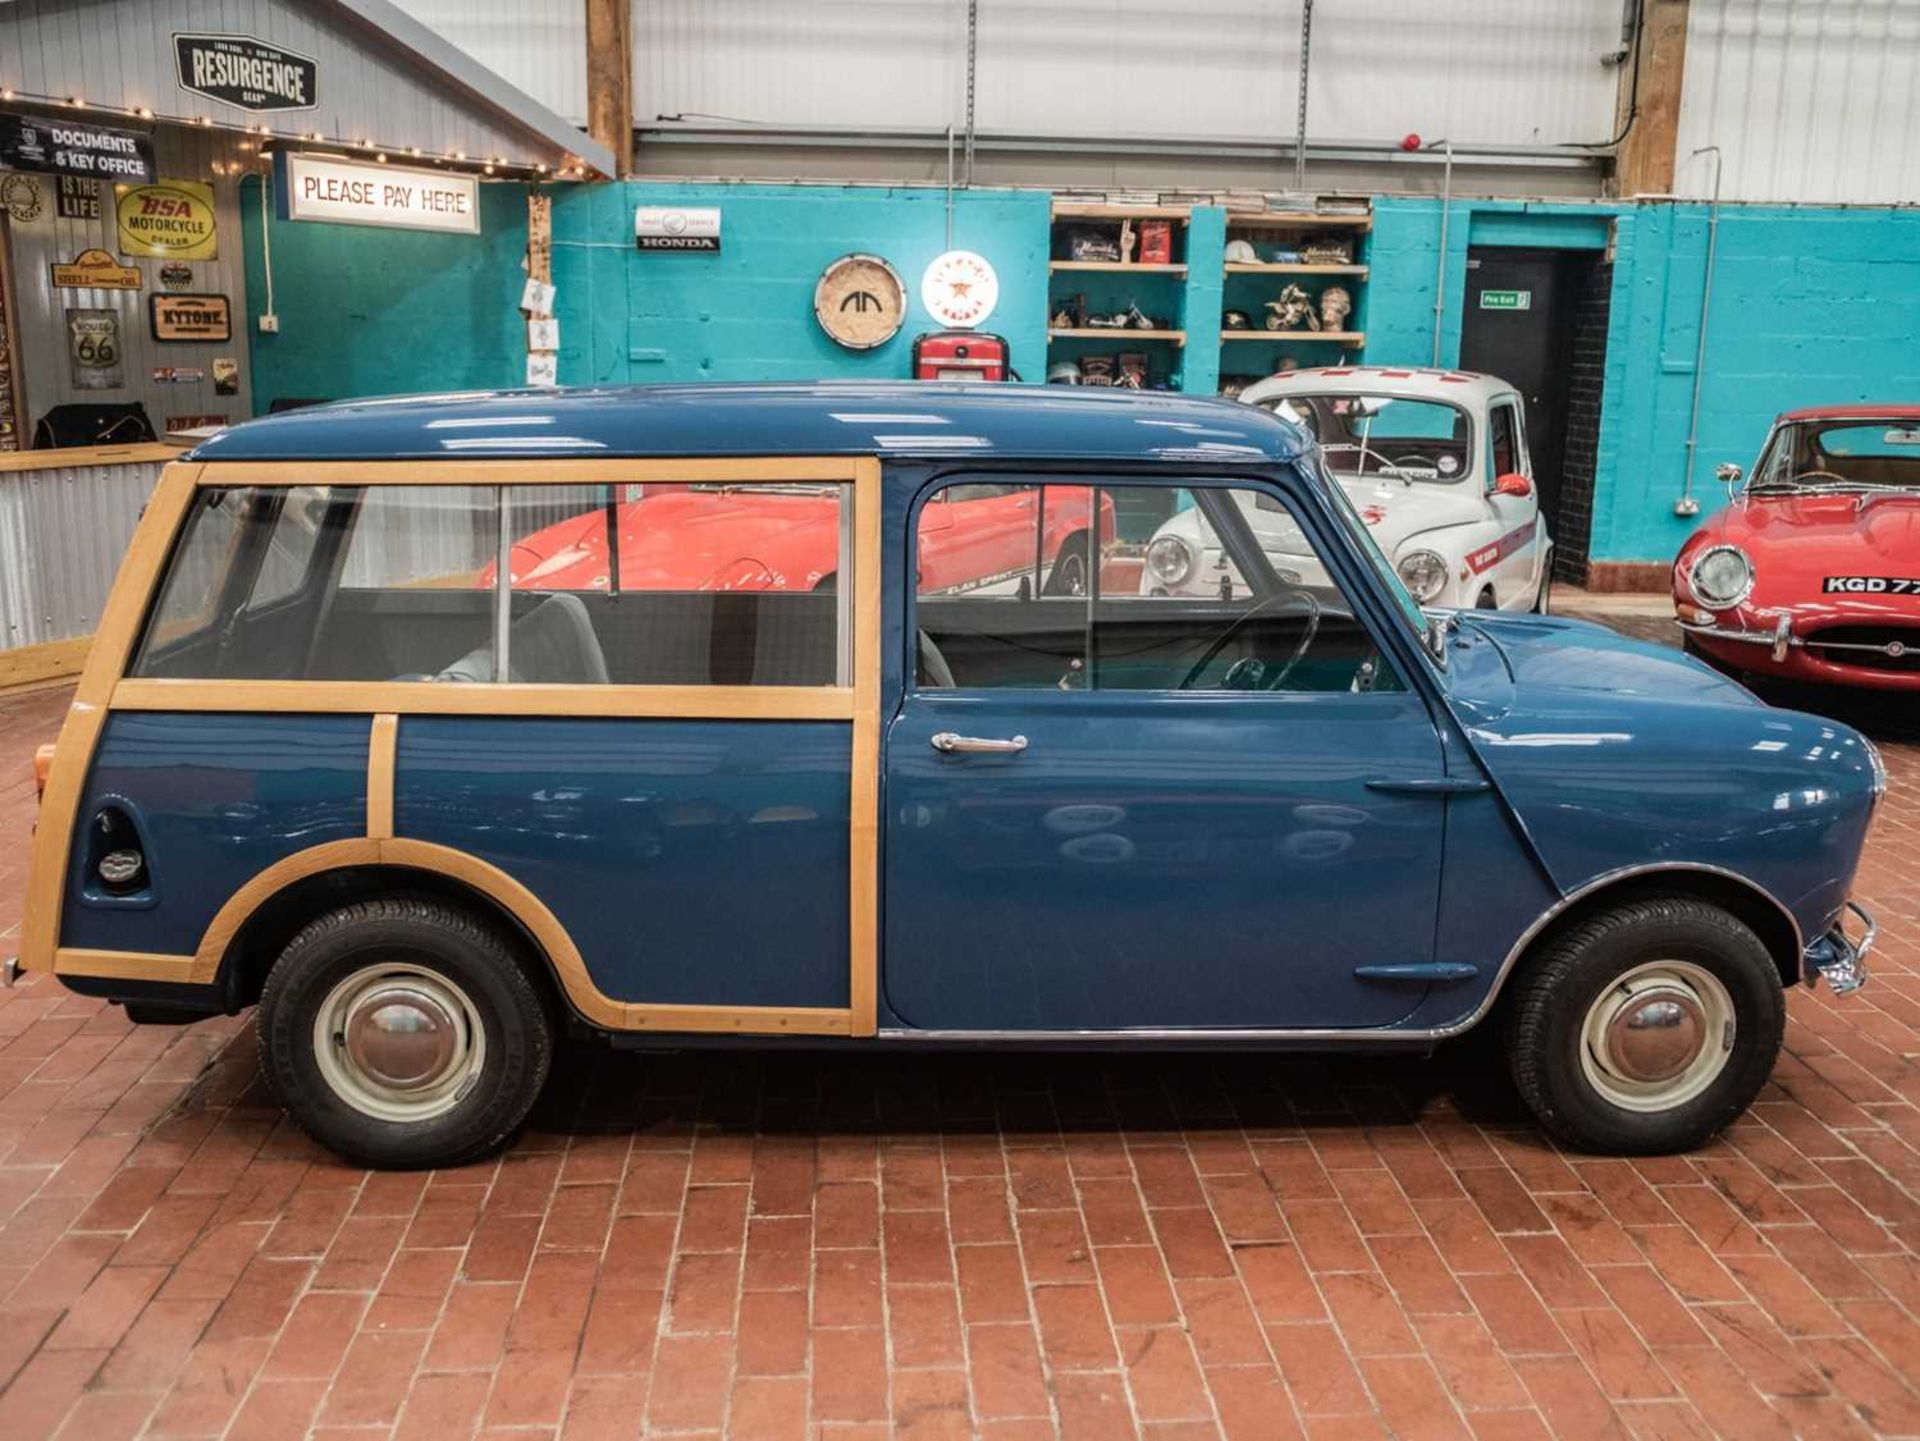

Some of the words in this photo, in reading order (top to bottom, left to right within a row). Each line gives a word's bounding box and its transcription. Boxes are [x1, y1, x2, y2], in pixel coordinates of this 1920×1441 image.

[192, 47, 306, 105] RESURGENCE
[51, 129, 136, 153] DOCUMENTS
[55, 151, 66, 166] &
[68, 152, 95, 170] KEY
[98, 156, 145, 175] OFFICE
[76, 178, 98, 197] THE
[304, 176, 375, 205] PLEASE
[384, 185, 413, 209] PAY
[421, 189, 467, 214] HERE
[63, 198, 99, 217] LIFE
[138, 194, 192, 218] BSA
[129, 216, 204, 234] MOTORCYCLE
[151, 235, 189, 245] DEALER
[642, 238, 715, 248] HONDA
[57, 274, 93, 285] SHELL
[79, 336, 113, 361] 66
[947, 582, 977, 595] ELAN
[979, 571, 1013, 586] SPRINT
[1827, 577, 1887, 592] KGD
